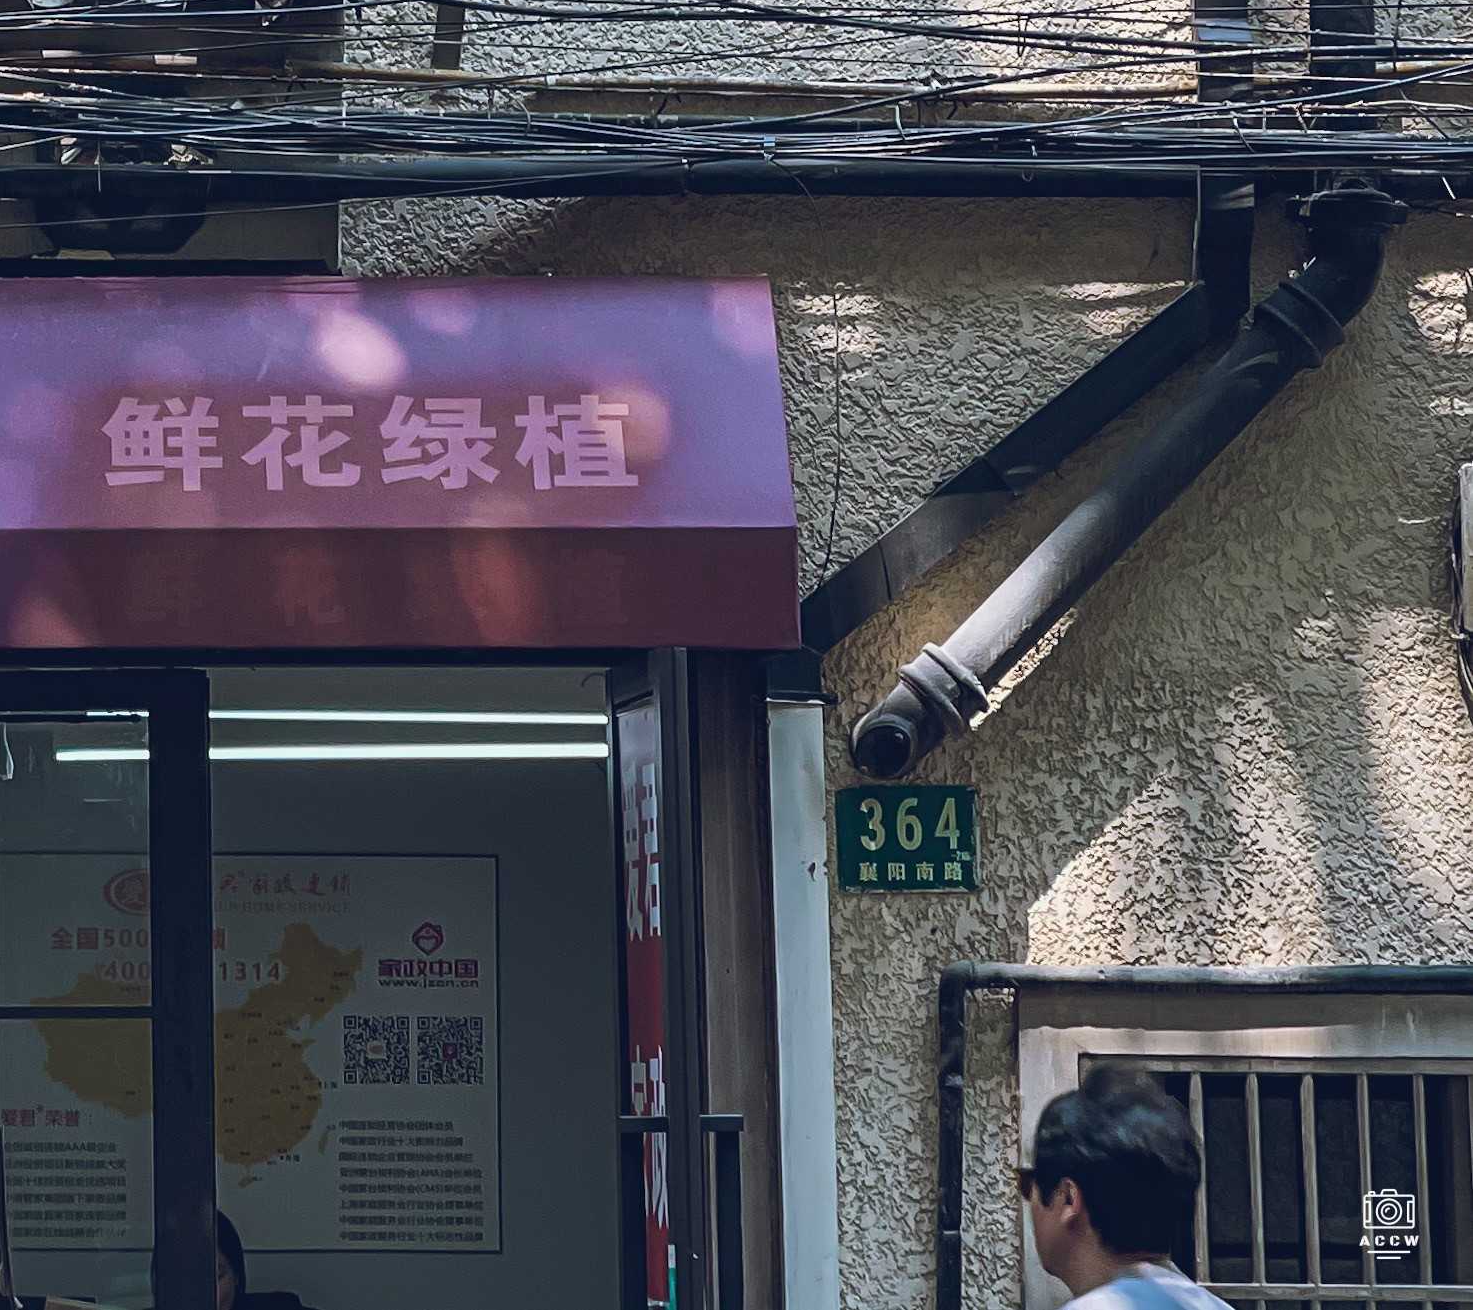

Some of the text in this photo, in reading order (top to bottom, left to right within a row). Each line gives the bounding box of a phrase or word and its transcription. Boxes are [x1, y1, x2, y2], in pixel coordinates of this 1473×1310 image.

[99, 393, 641, 493] 鲜花绿植
[860, 797, 960, 851] 364
[859, 861, 963, 881] 襄阳南路
[378, 958, 479, 978] 家政中国
